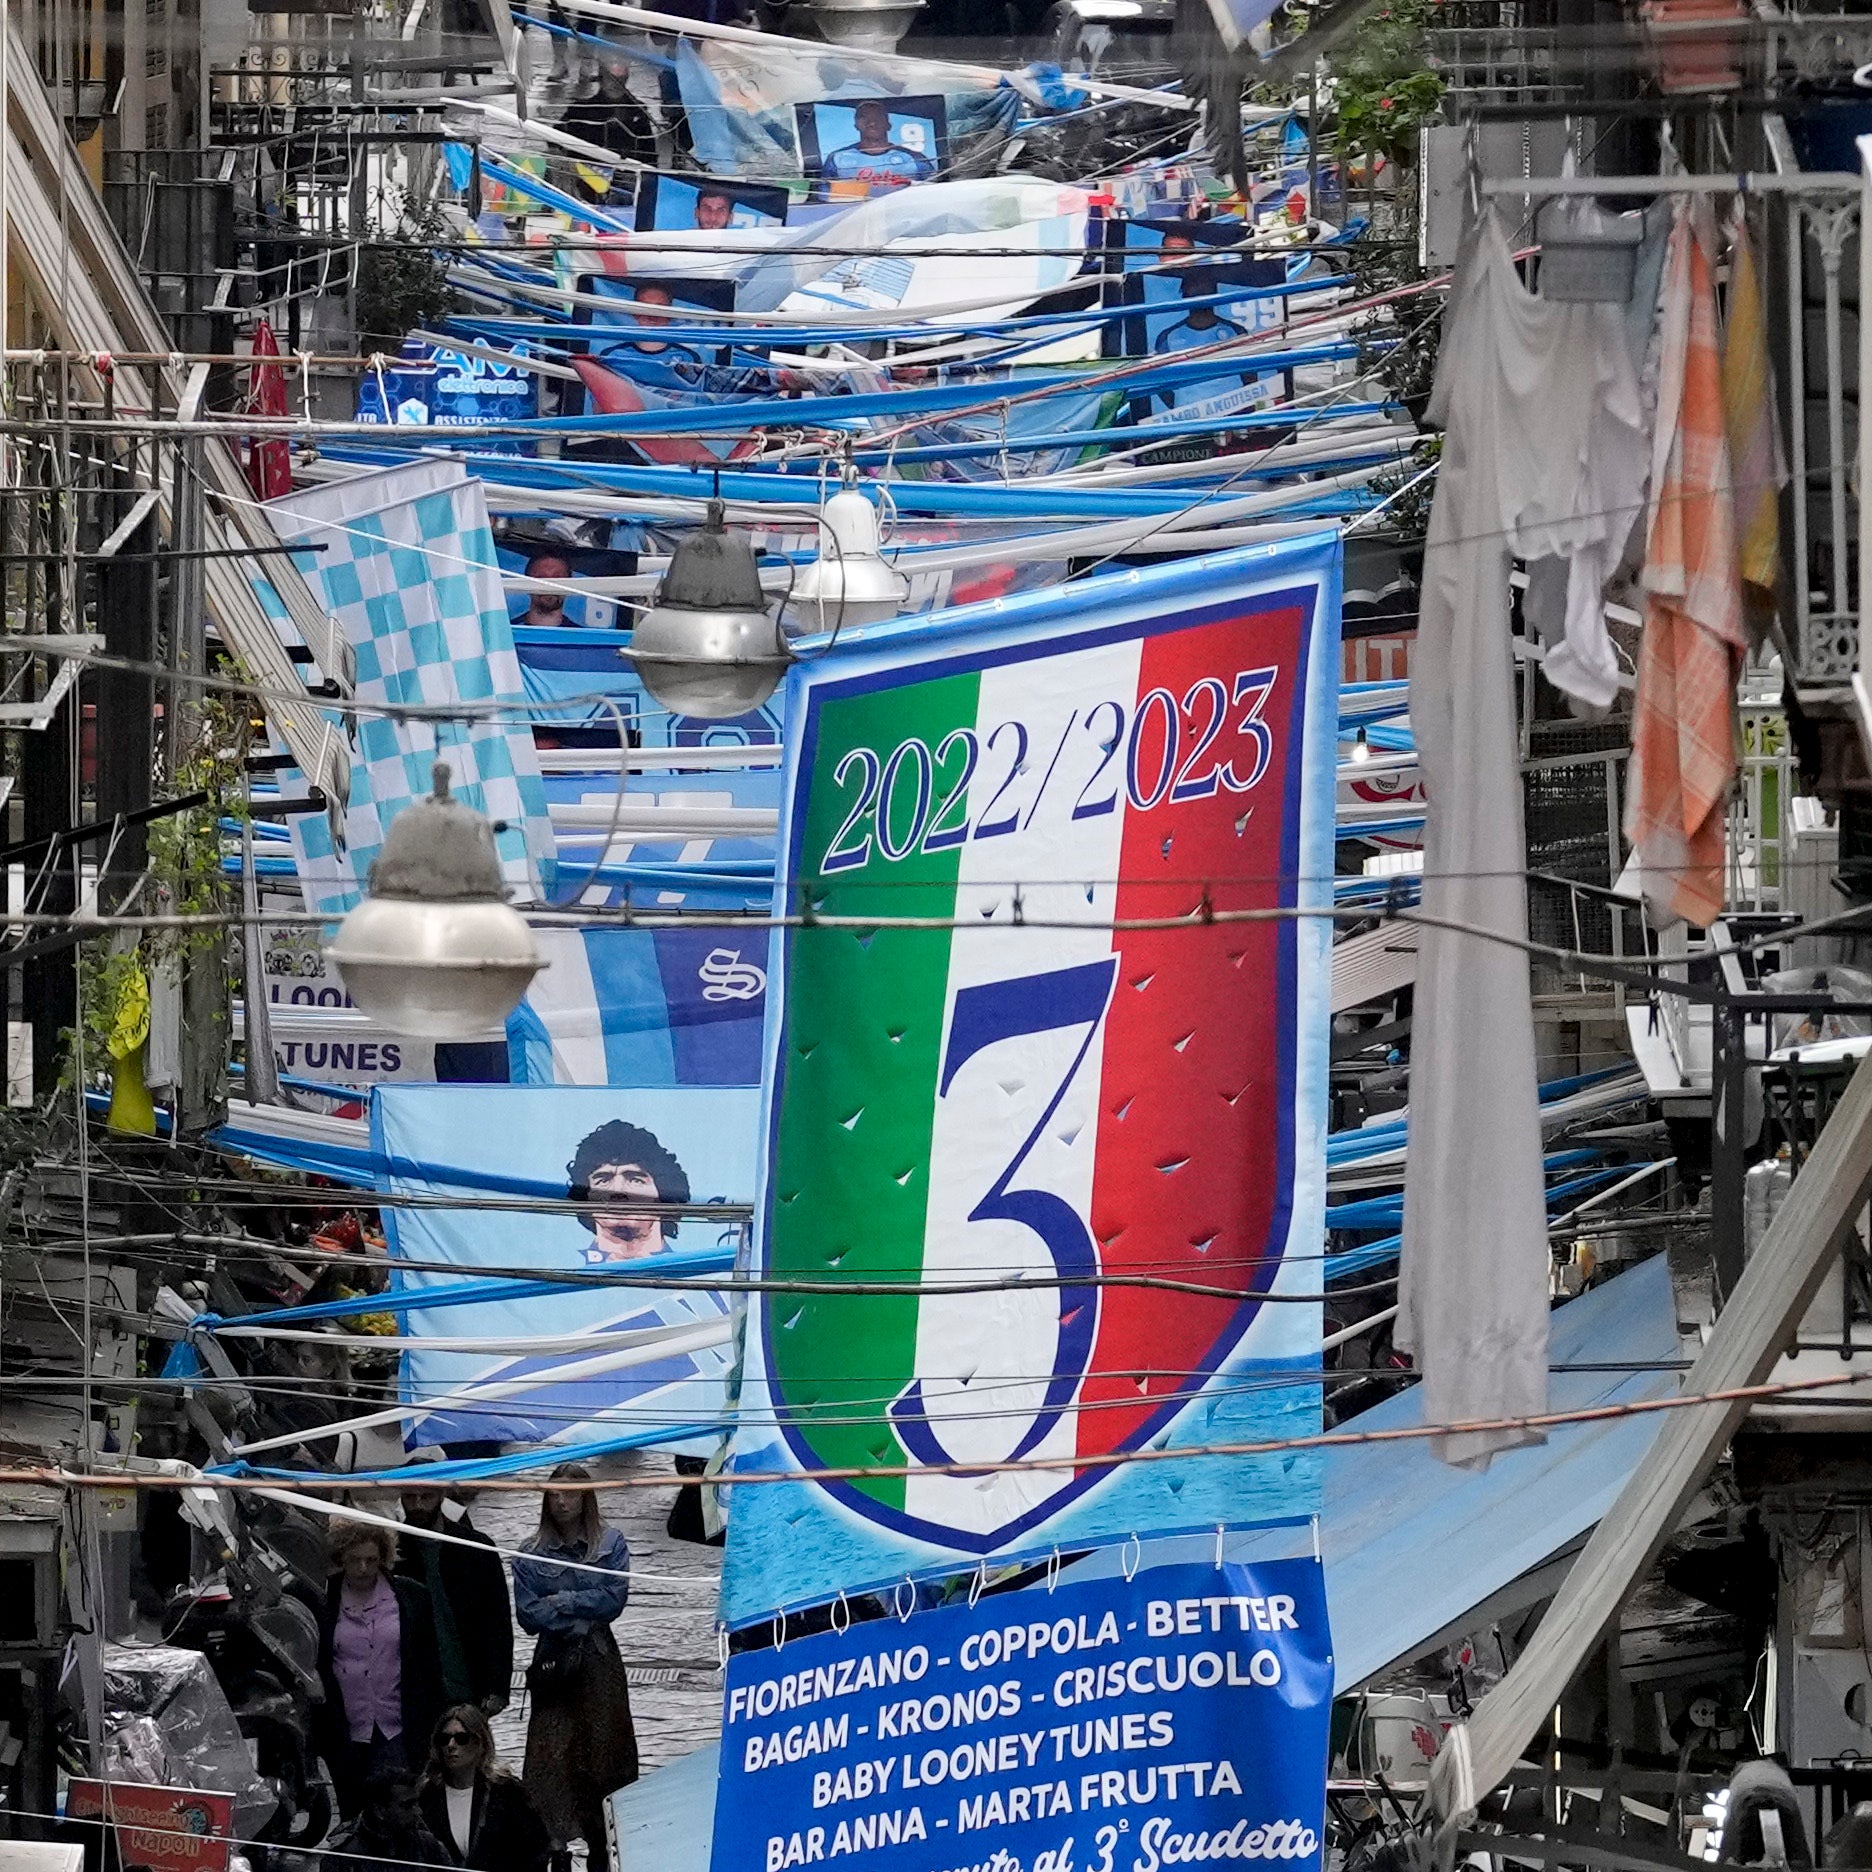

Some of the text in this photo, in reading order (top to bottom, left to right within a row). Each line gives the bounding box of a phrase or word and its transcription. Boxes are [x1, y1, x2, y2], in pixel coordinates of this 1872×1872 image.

[1230, 296, 1277, 330] 99
[437, 374, 528, 396] elettronica
[821, 664, 1280, 876] 2022/2023
[281, 1041, 402, 1073] TUNES
[886, 952, 1122, 1480] 3
[728, 1644, 929, 1724] FIORENZANO
[960, 1610, 1120, 1673] COPPOLA
[1147, 1594, 1300, 1637] BETTER
[743, 1712, 850, 1773] BAGAM
[877, 1680, 1022, 1741] KRONOS
[1053, 1648, 1282, 1708] CRISCUOLO
[812, 1711, 1175, 1809] BABY LOONEY TUNES
[829, 1805, 928, 1858] ANNA
[957, 1780, 1073, 1834] MARTA
[1080, 1760, 1244, 1812] FRUTTA
